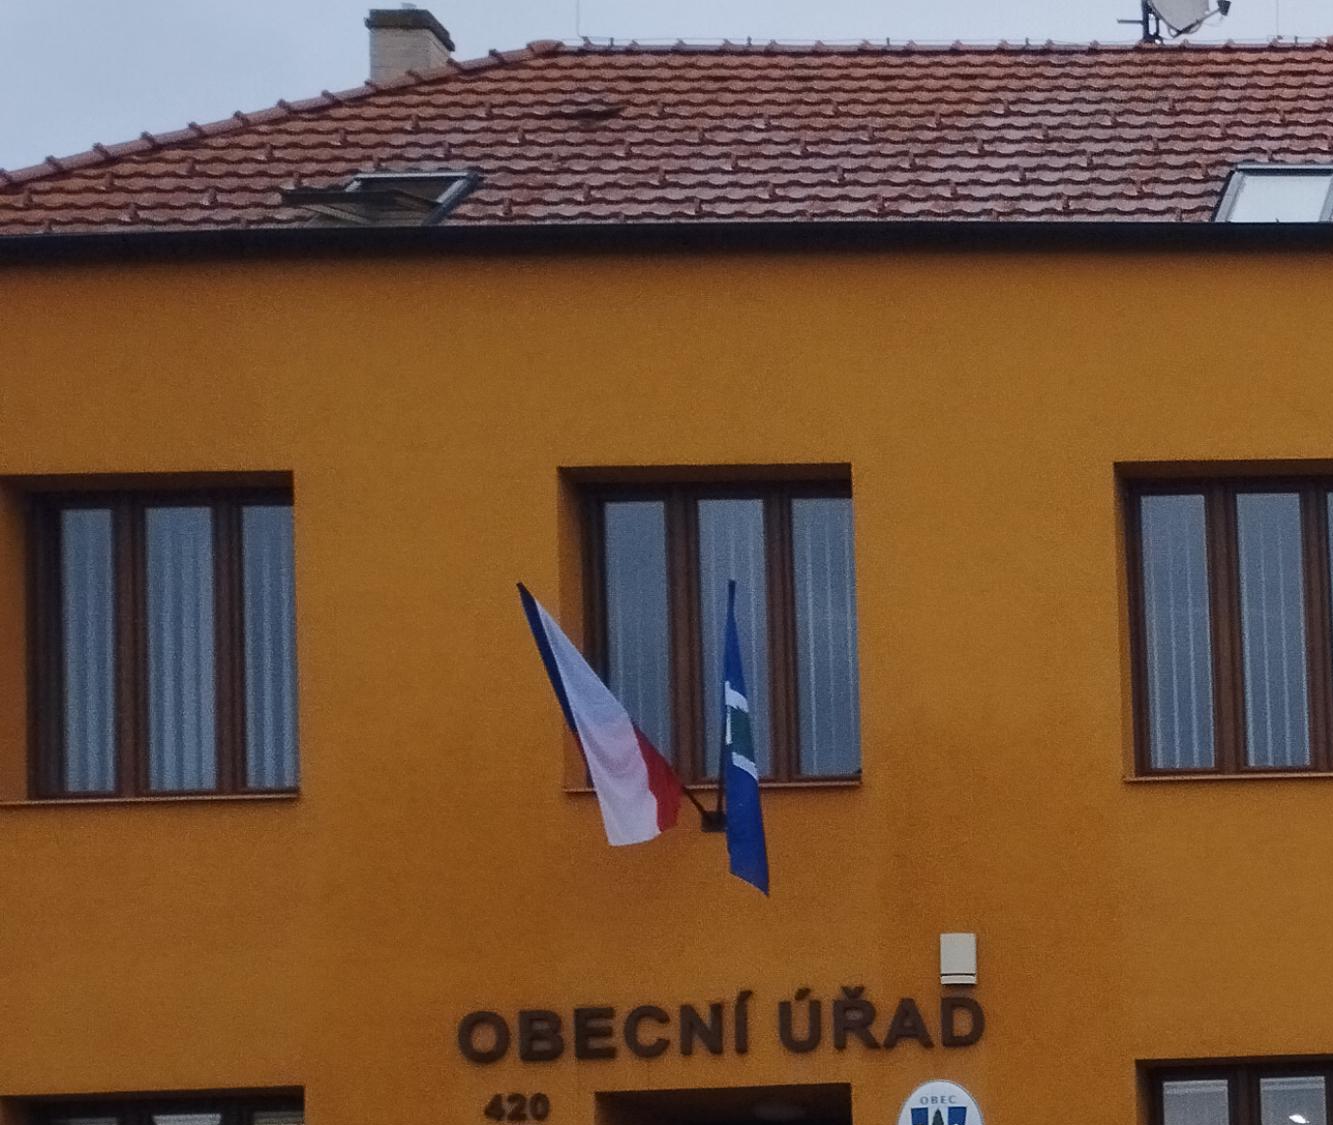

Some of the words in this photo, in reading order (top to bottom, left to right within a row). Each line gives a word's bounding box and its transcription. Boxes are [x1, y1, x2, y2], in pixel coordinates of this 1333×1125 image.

[458, 990, 753, 1064] OBECNÍ
[778, 985, 986, 1053] ÚŘAD
[483, 1092, 550, 1122] 420
[919, 1095, 957, 1105] OBEC
